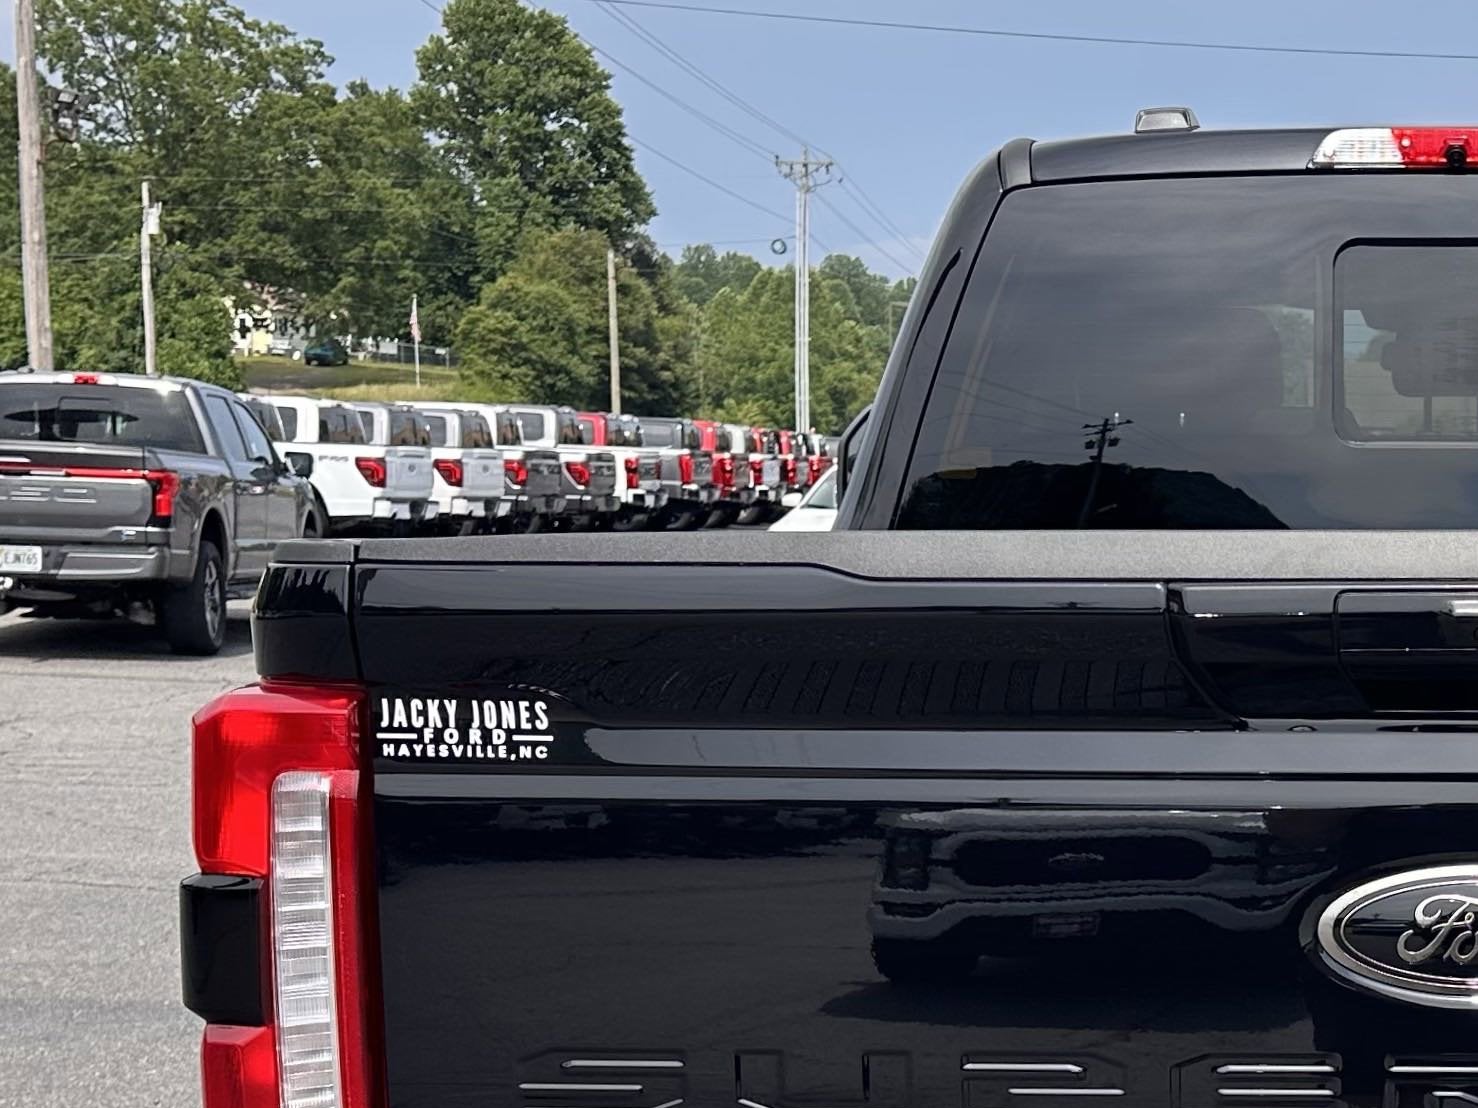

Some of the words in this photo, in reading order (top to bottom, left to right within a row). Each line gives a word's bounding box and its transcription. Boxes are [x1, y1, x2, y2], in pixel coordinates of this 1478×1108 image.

[380, 698, 457, 729] JACKY
[471, 699, 549, 731] JONES
[423, 728, 507, 745] FORD
